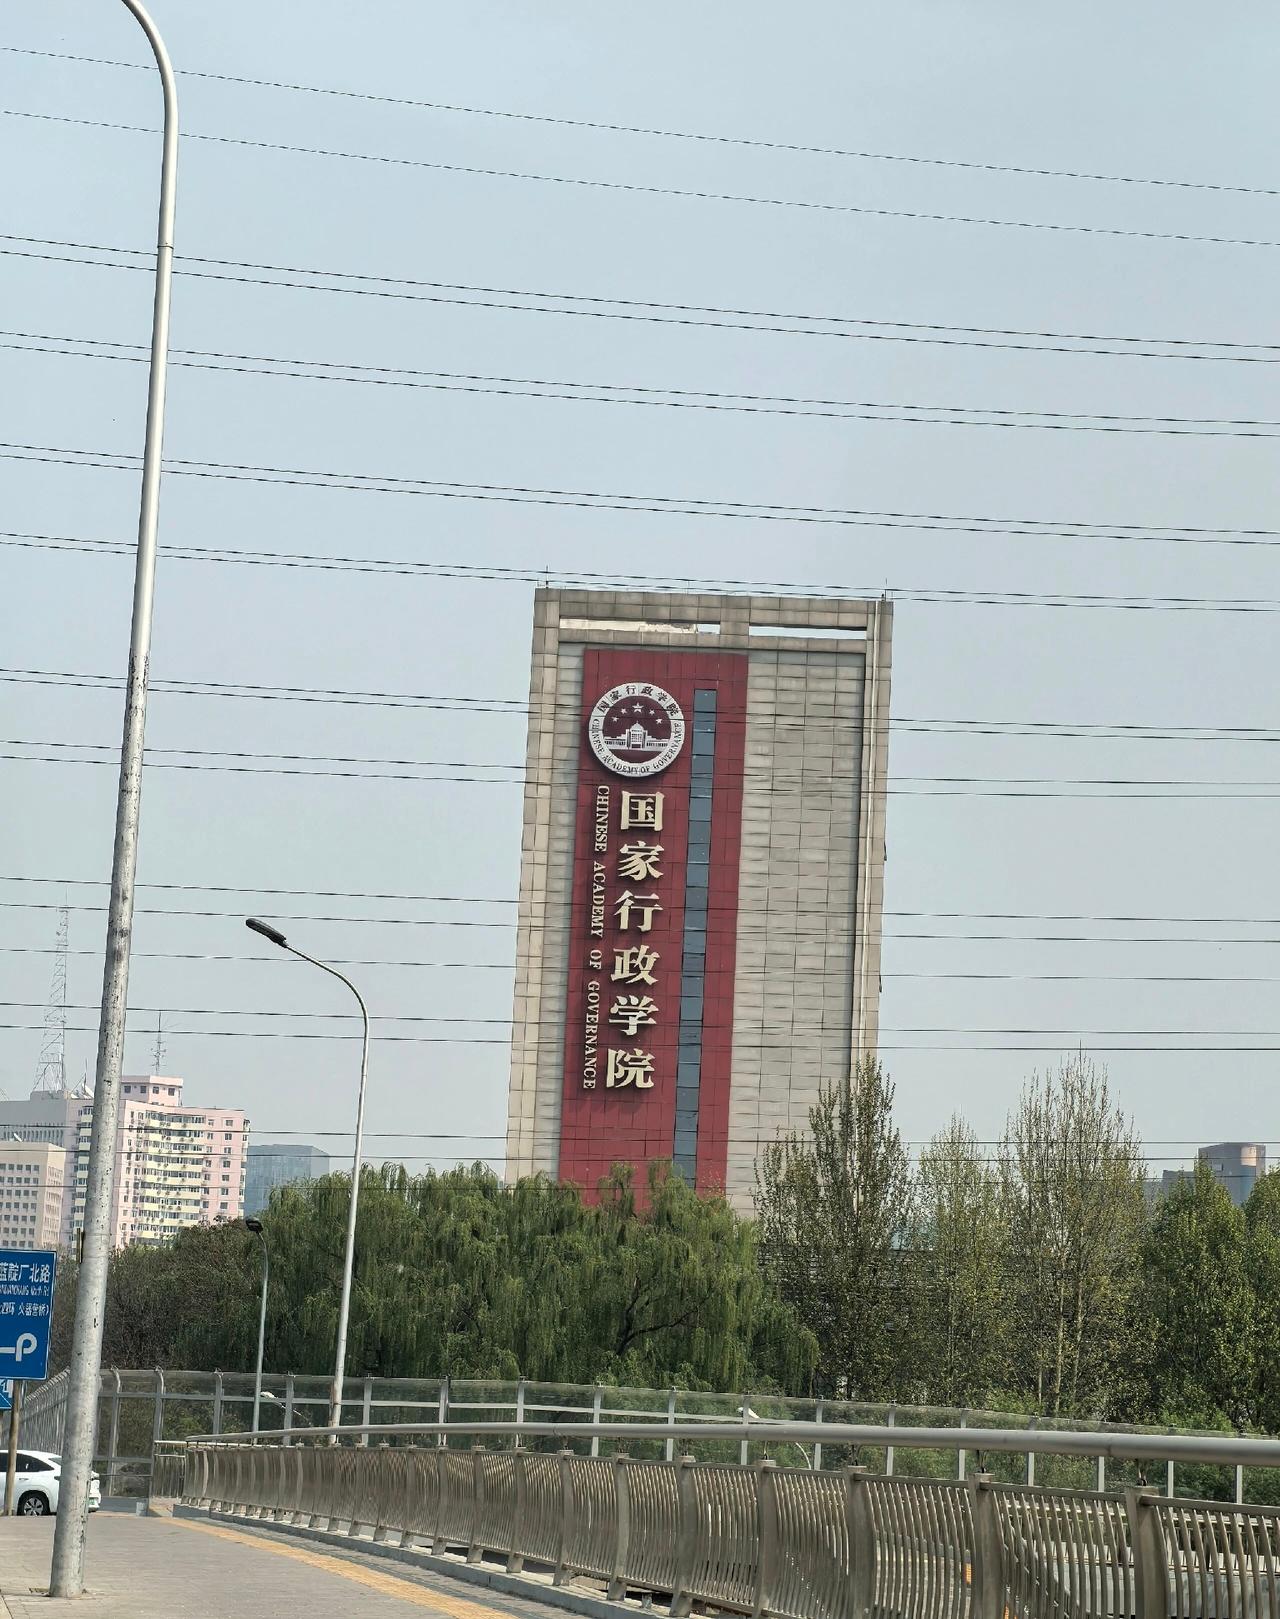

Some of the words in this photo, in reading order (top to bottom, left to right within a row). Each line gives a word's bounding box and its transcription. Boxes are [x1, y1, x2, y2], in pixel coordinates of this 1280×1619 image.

[597, 685, 679, 716] 国家行政学院
[592, 718, 605, 756] CHINESE
[602, 755, 638, 774] ACADEMY
[640, 765, 651, 774] OF
[653, 722, 682, 770] GOVERNANCE
[594, 785, 609, 852] CHINESE
[591, 861, 606, 939] ACADEMY
[589, 949, 602, 970] OF
[606, 790, 665, 1090] 国家行政学院
[583, 980, 600, 1090] GOVERNANCE
